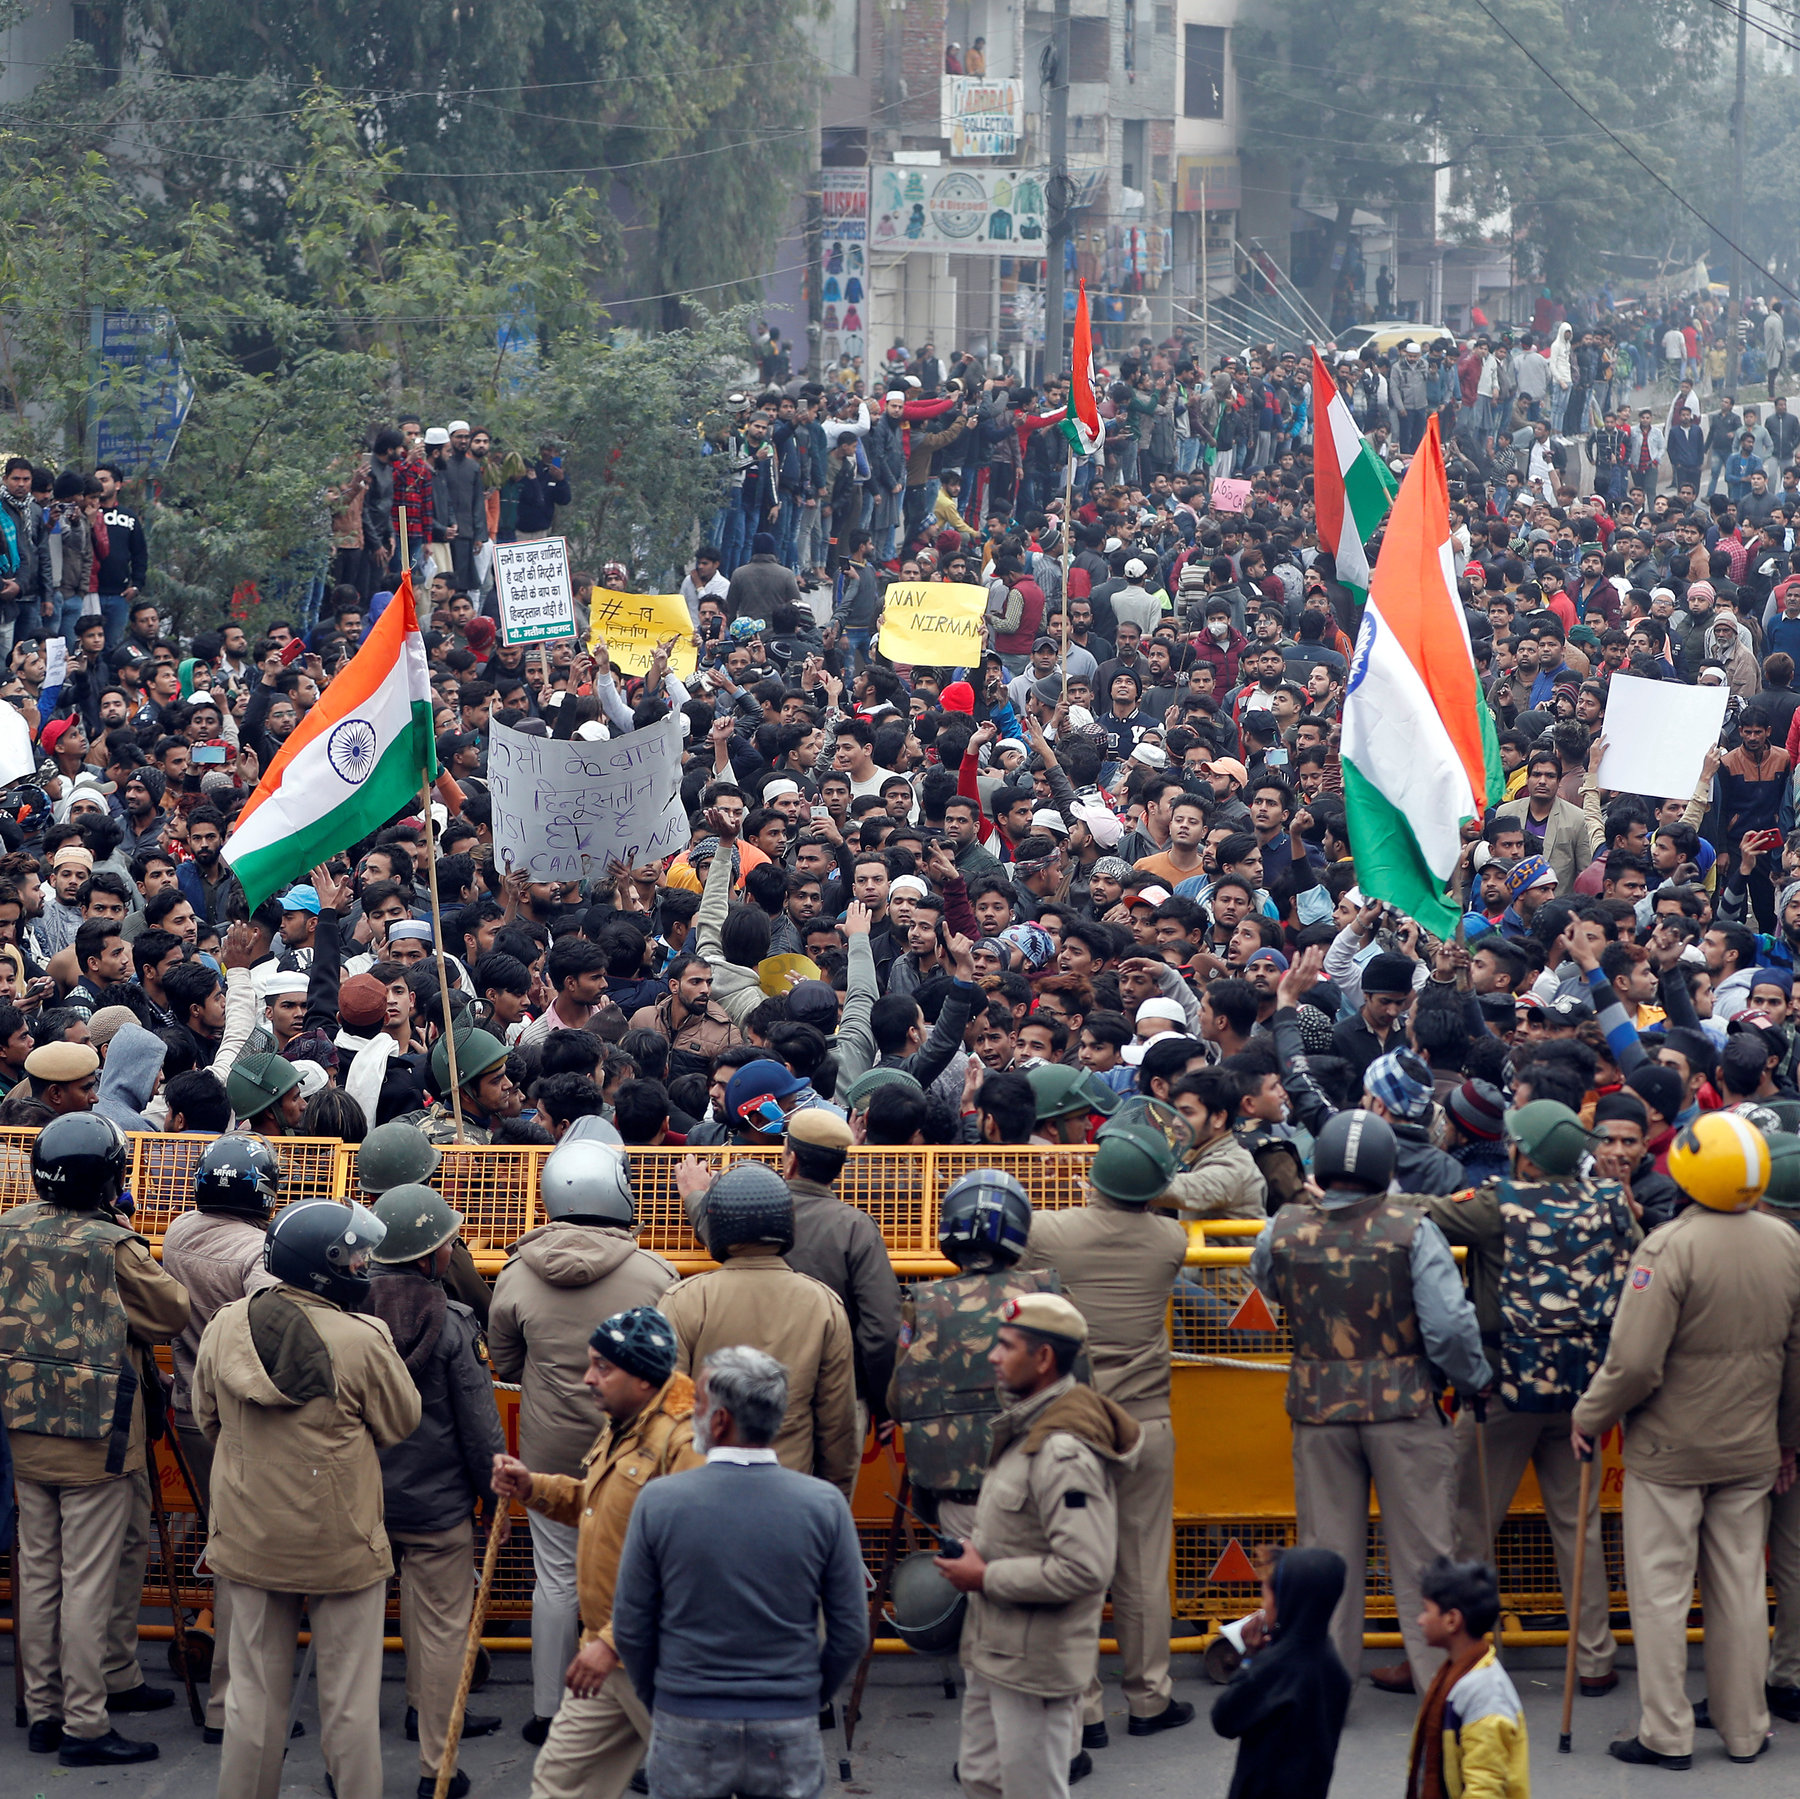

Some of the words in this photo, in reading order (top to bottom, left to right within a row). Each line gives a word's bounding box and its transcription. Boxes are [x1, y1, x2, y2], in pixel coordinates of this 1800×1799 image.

[963, 117, 1014, 132] COLLECTION
[1233, 495, 1246, 509] CA
[500, 549, 514, 565] सभी
[515, 552, 525, 563] का
[526, 550, 540, 565] खून
[541, 544, 562, 560] शामिल
[506, 568, 512, 584] है
[526, 565, 536, 580] की
[510, 585, 528, 601] किसी
[529, 585, 536, 599] के
[538, 586, 550, 598] बाप
[551, 585, 561, 596] का
[889, 590, 926, 607] NAV
[510, 605, 541, 625] हिन्दुस्तान
[542, 600, 557, 619] थोड़ी
[523, 626, 545, 637] मतीन
[546, 624, 571, 634] अहमद
[605, 621, 648, 638] निर्माण
[629, 653, 655, 669] PAR
[565, 743, 611, 777] के
[610, 733, 667, 771] बाप
[645, 812, 686, 854] NRC
[35, 1165, 66, 1182] NINJA
